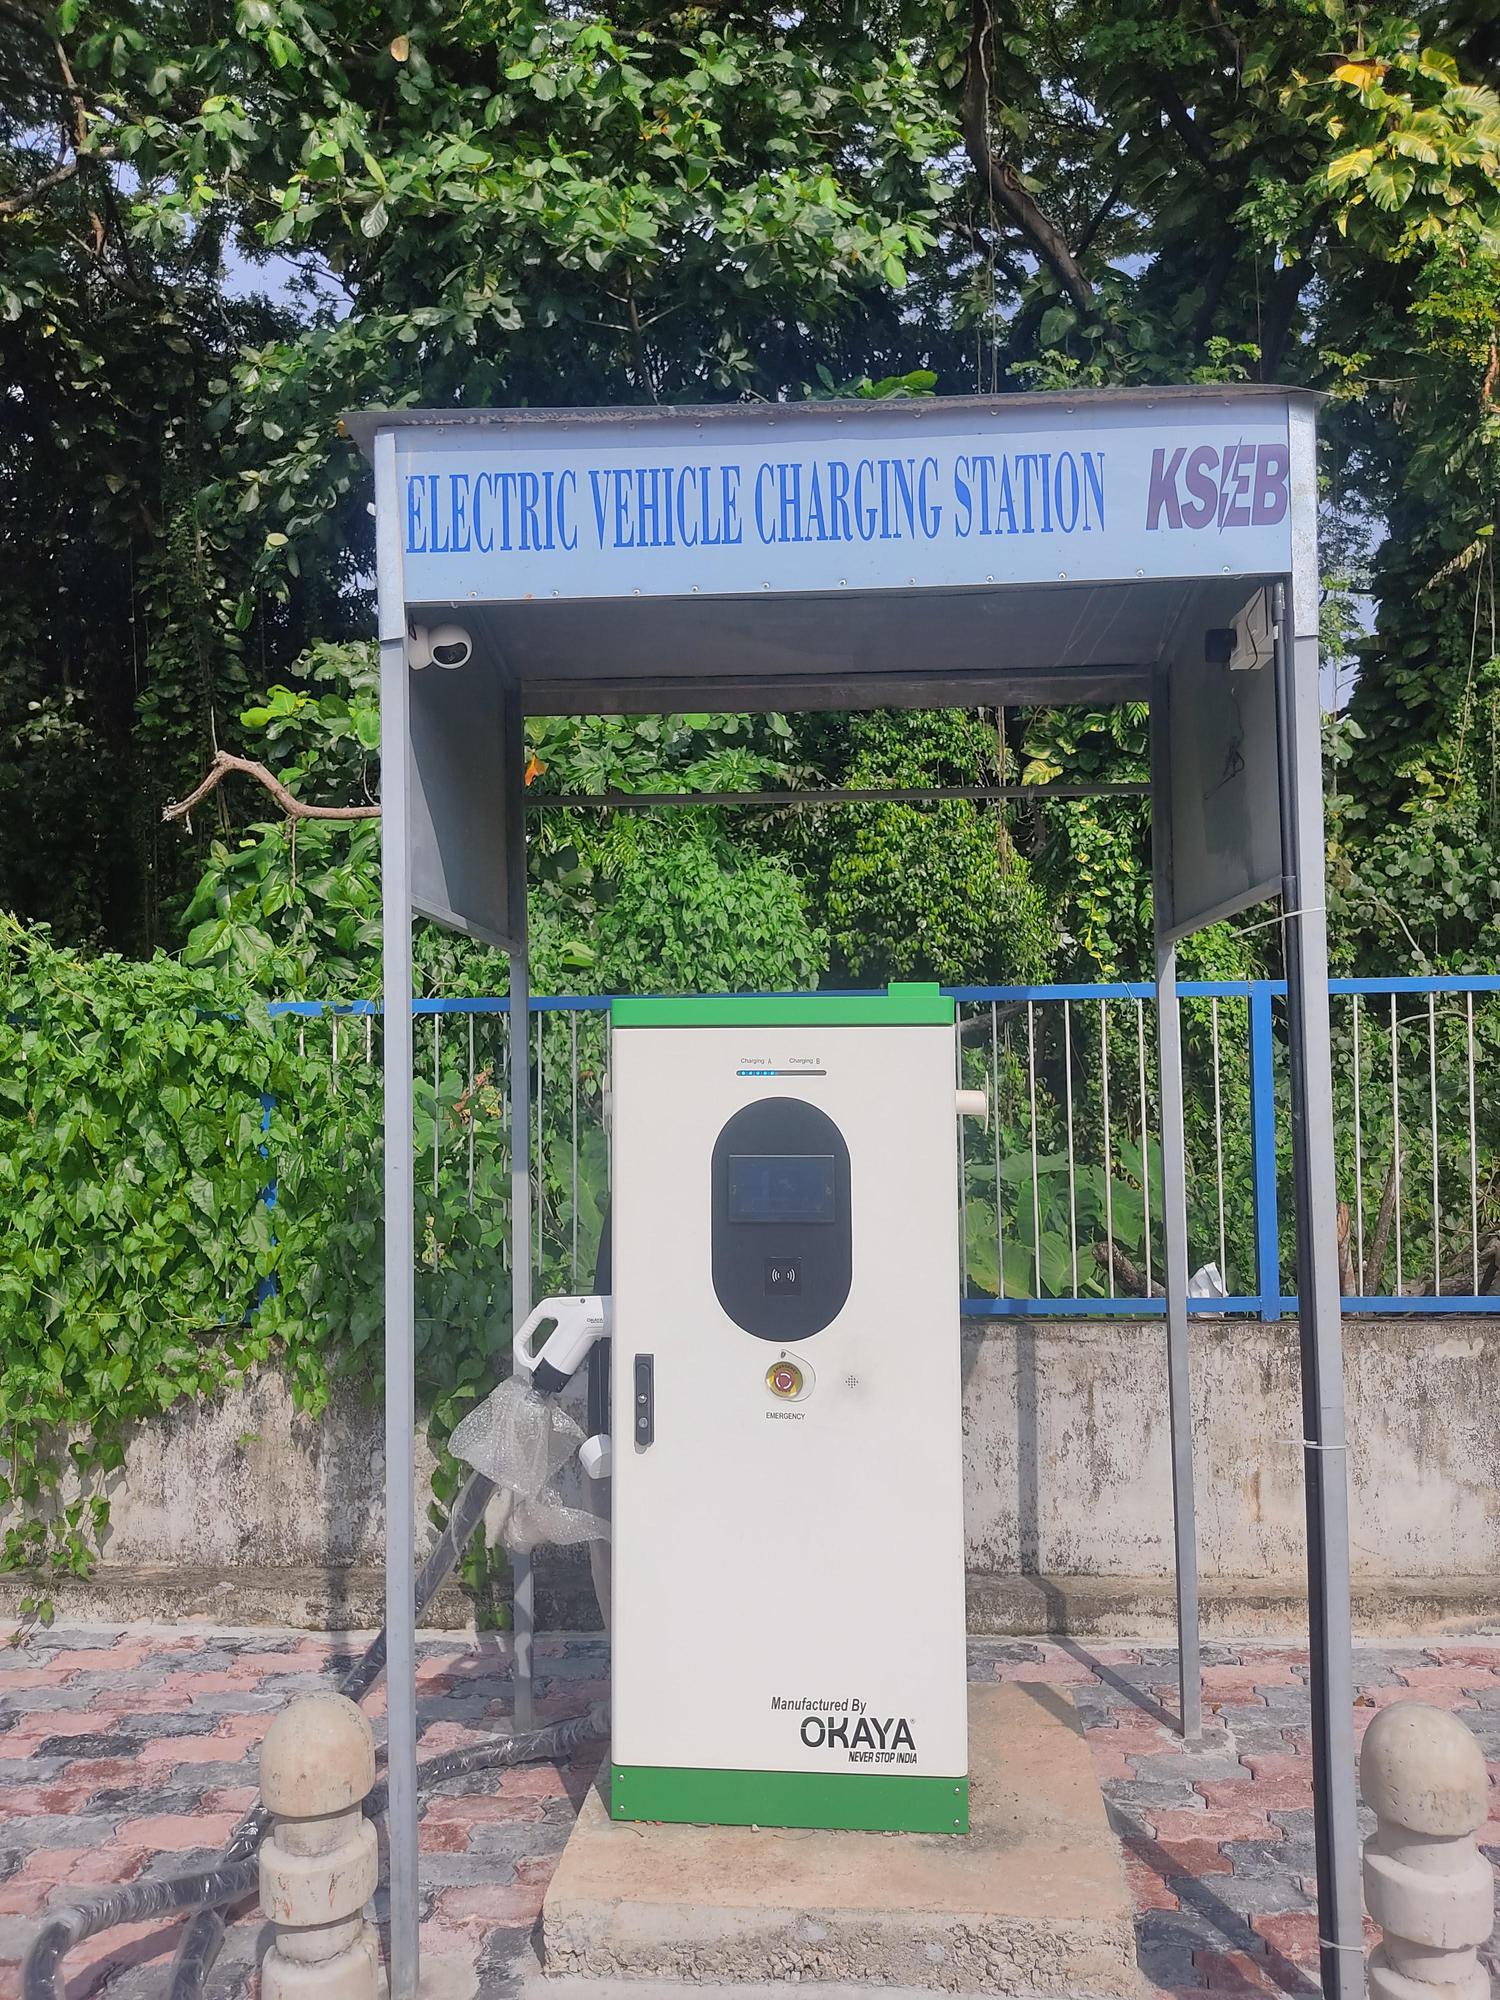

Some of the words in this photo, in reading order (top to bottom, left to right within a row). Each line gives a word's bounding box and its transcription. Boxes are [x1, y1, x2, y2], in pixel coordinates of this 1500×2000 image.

[1146, 441, 1289, 532] KSEB
[406, 470, 577, 553] ELECTRIC
[588, 466, 742, 550] VEHICLE
[755, 457, 942, 544] CHARGING
[954, 451, 1105, 538] STATION
[766, 1412, 806, 1420] EMERGENCY
[771, 1697, 848, 1711] Manufactured
[851, 1699, 867, 1715] By
[800, 1716, 916, 1750] OKAYA
[848, 1752, 874, 1763] NEVER
[875, 1752, 896, 1763] STOP
[896, 1753, 918, 1764] INDIA
